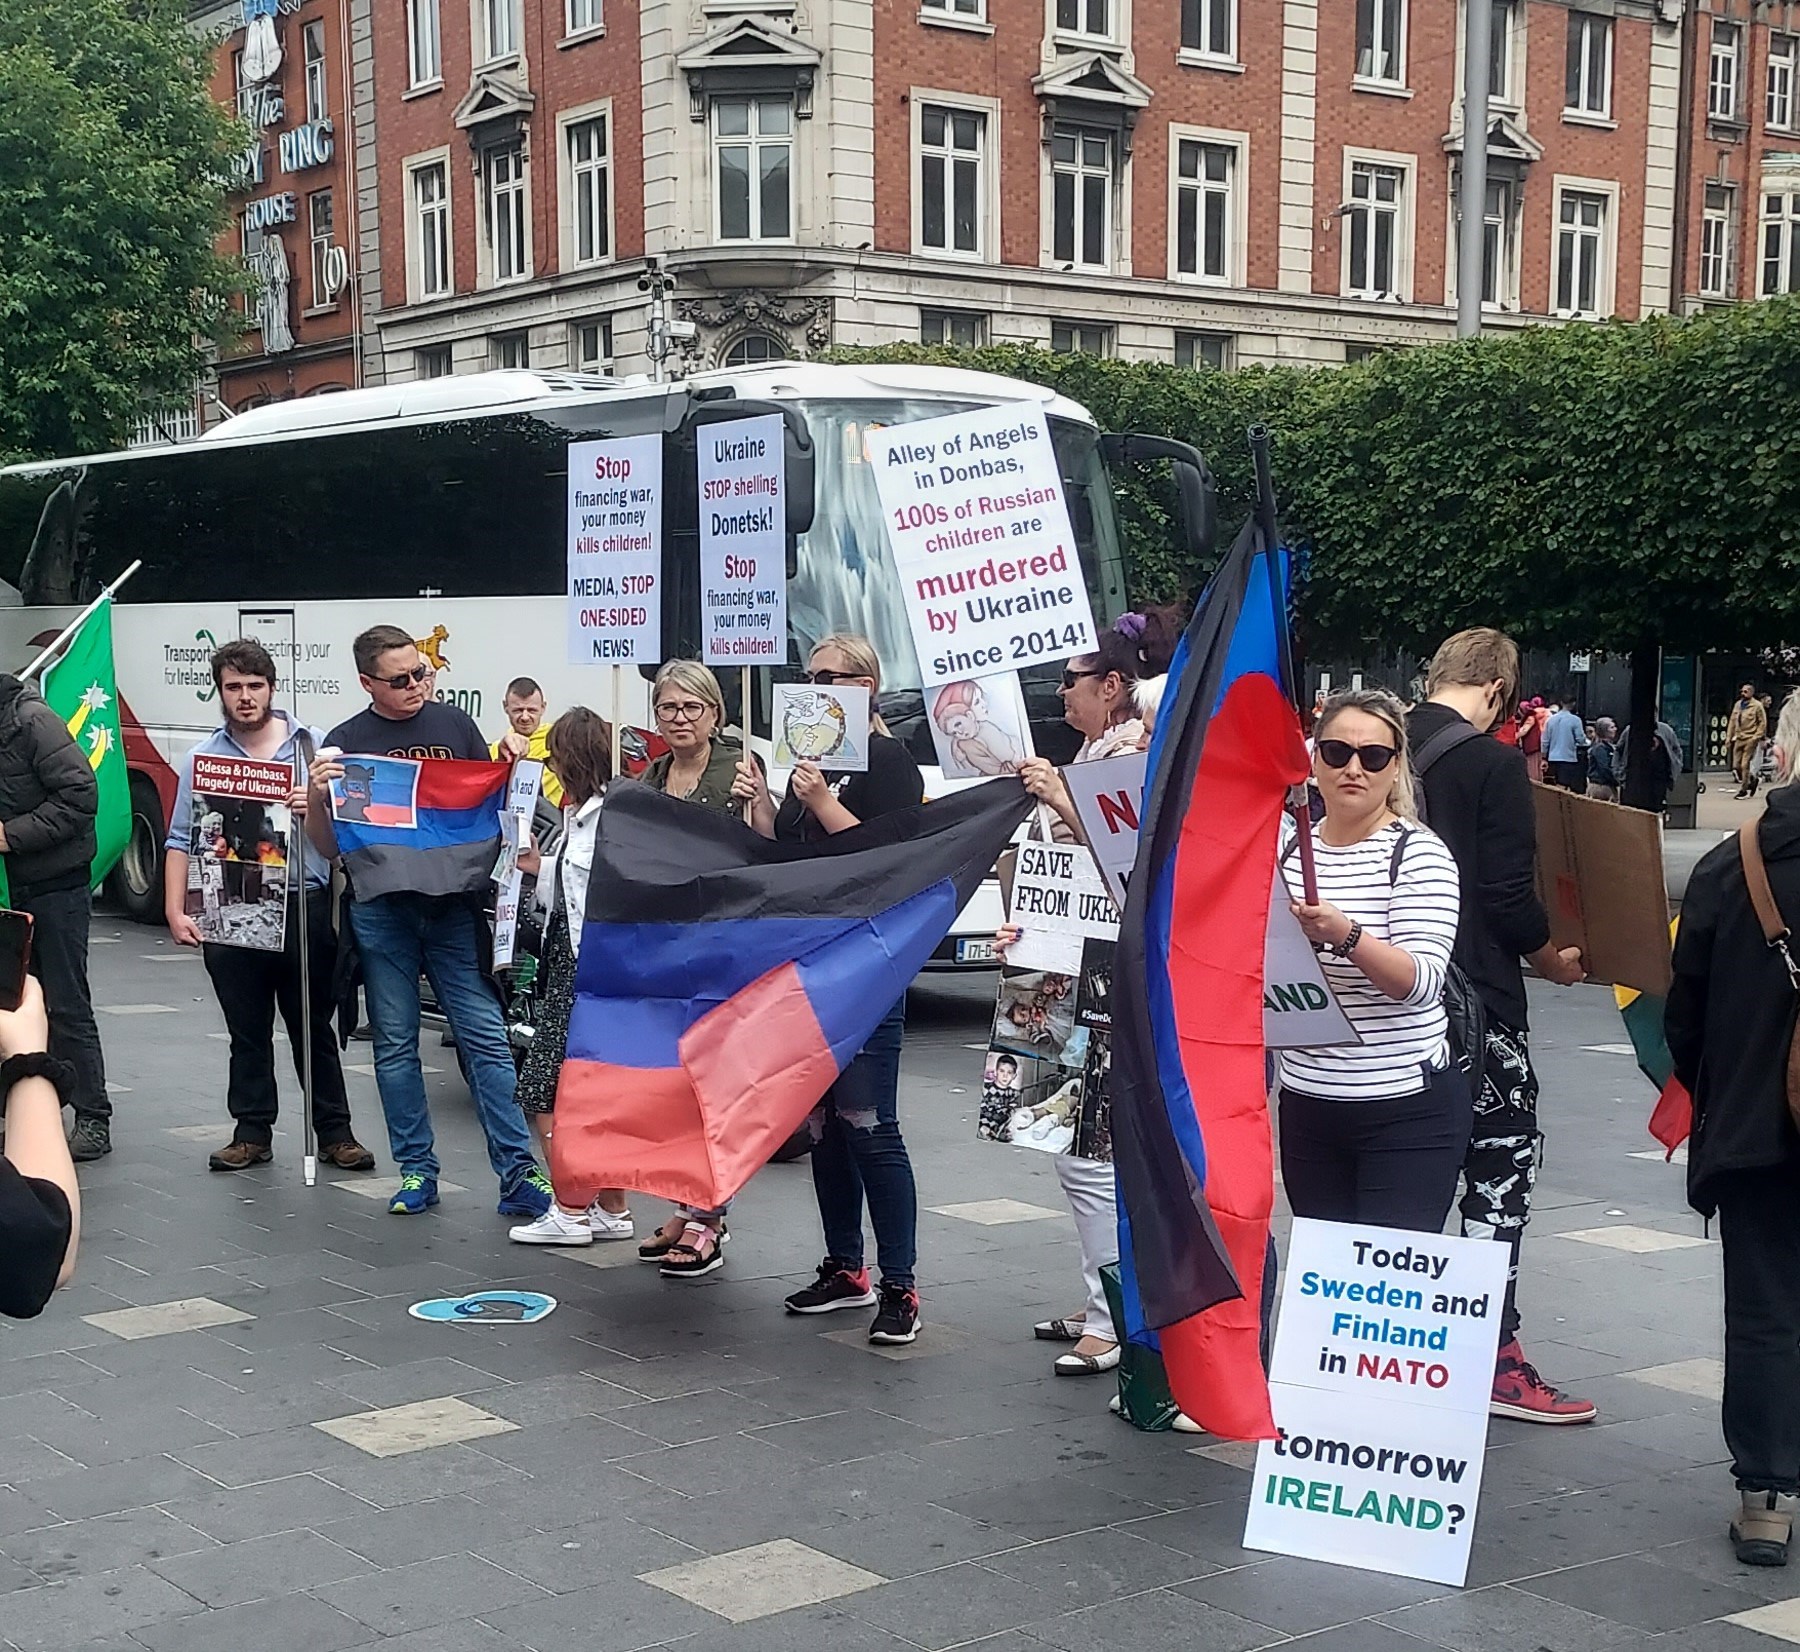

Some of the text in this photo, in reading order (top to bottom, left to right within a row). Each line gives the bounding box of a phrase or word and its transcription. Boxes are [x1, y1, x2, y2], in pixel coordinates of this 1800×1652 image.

[279, 117, 334, 174] RING
[245, 191, 296, 231] HOUSE
[714, 436, 766, 463] Ukraine
[887, 423, 1038, 466] Alley of Angels
[595, 456, 631, 483] Stop
[914, 455, 1024, 490] in Donbas,
[574, 488, 654, 509] financing war,
[704, 474, 778, 500] STOP shelling
[582, 510, 646, 531] your money
[712, 506, 773, 536] Donetsk!
[894, 486, 1057, 532] 100s of Russian
[576, 532, 652, 554] kills children!
[925, 517, 1042, 554] children are
[724, 554, 756, 583] Stop
[916, 544, 1068, 600] murdered
[573, 575, 654, 599] MEDIA, STOP
[706, 588, 778, 610] financing war,
[580, 608, 646, 628] ONE-SIDED
[714, 611, 772, 630] your money
[926, 586, 1074, 634] by Ukraine
[164, 644, 211, 666] Transport
[305, 643, 331, 662] your
[592, 639, 634, 658] NEWS!
[710, 636, 778, 655] kills children!
[933, 622, 1088, 676] since 2014!
[164, 667, 212, 686] for Ireland
[294, 676, 340, 695] services
[195, 774, 236, 792] Tragedy
[236, 778, 247, 792] of
[196, 760, 288, 783] Odessa & Donbass.
[520, 779, 534, 796] and
[1096, 786, 1144, 834] N
[1020, 848, 1074, 880] SAVE
[1016, 886, 1071, 917] FROM
[1352, 1240, 1450, 1280] Today
[1300, 1272, 1490, 1318] Sweden and
[1332, 1314, 1448, 1351] Finland
[1319, 1346, 1449, 1389] in NATO
[1274, 1427, 1468, 1484] tomorrow
[1264, 1474, 1466, 1535] IRELAND?
